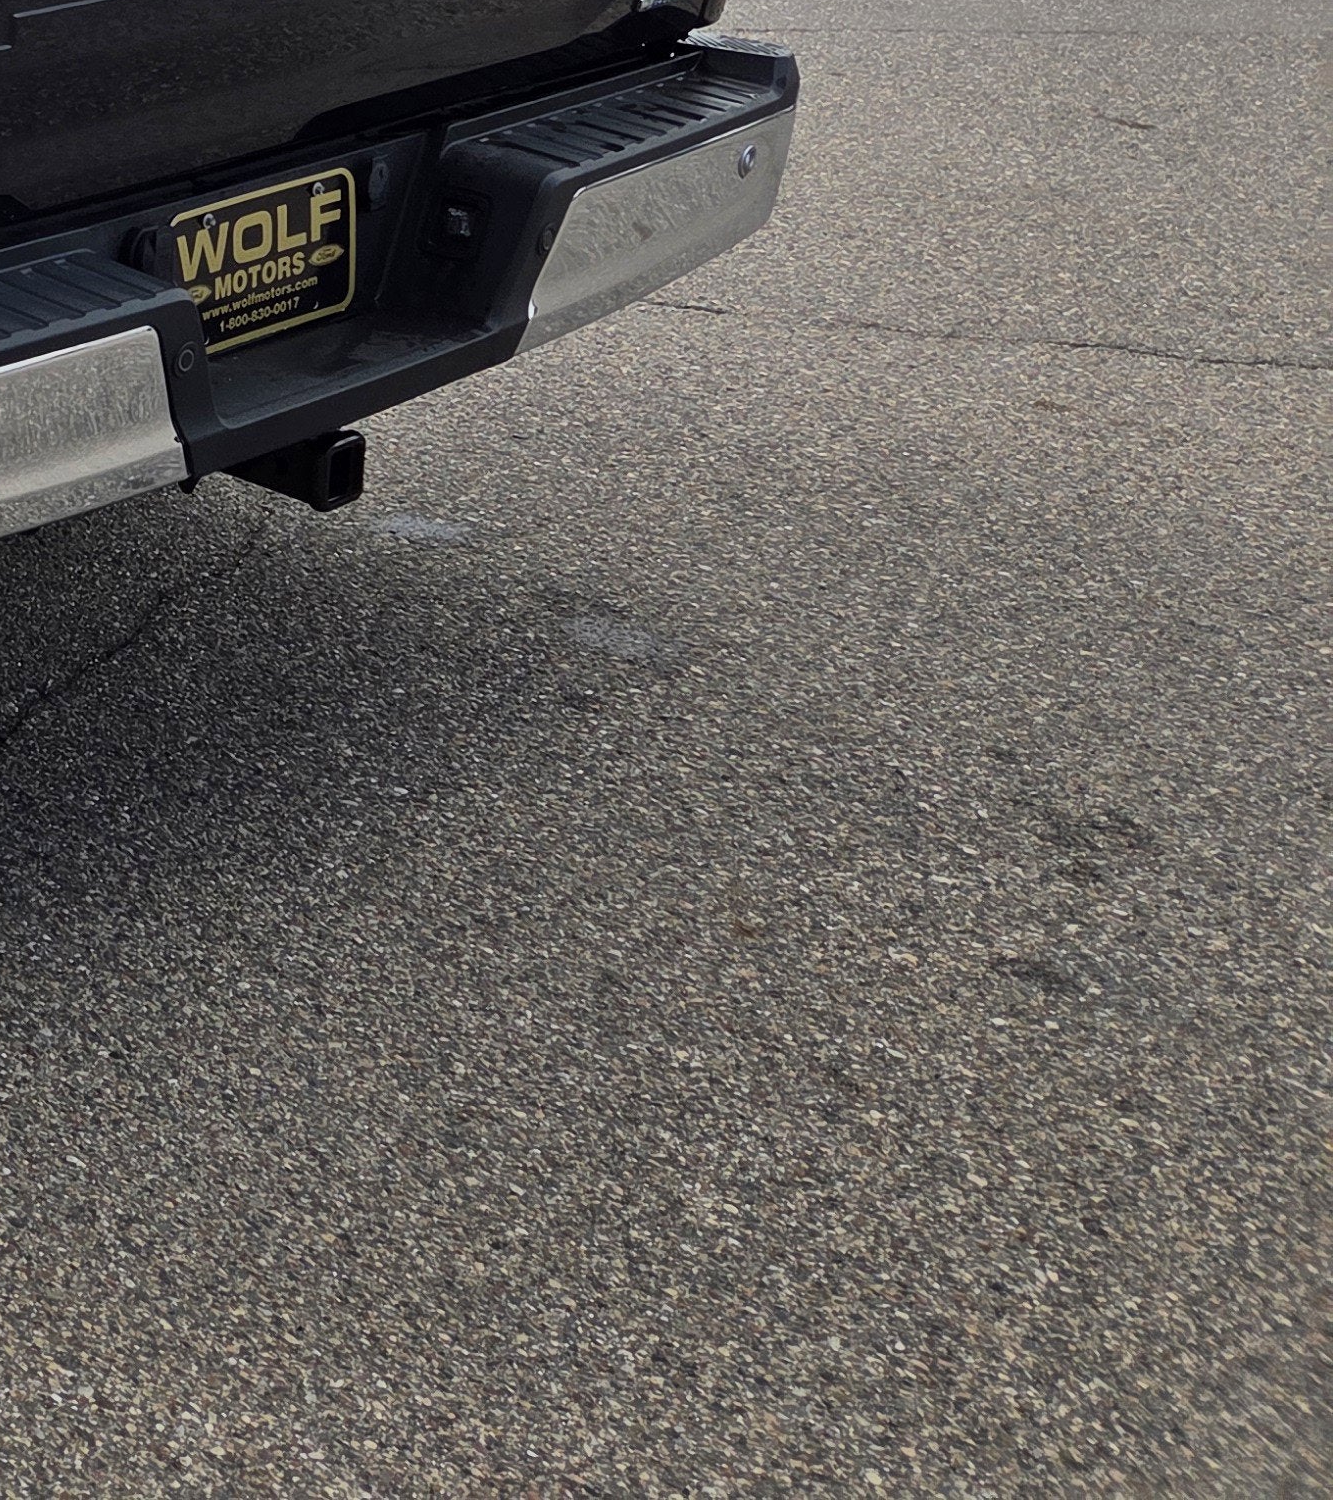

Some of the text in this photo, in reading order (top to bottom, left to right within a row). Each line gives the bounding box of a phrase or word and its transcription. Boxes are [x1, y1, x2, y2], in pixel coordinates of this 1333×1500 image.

[176, 188, 342, 283] WOLF
[201, 275, 319, 321] www.wolfmotors.com
[214, 251, 306, 301] MOTORS
[219, 296, 301, 333] 1-800-830-0017
